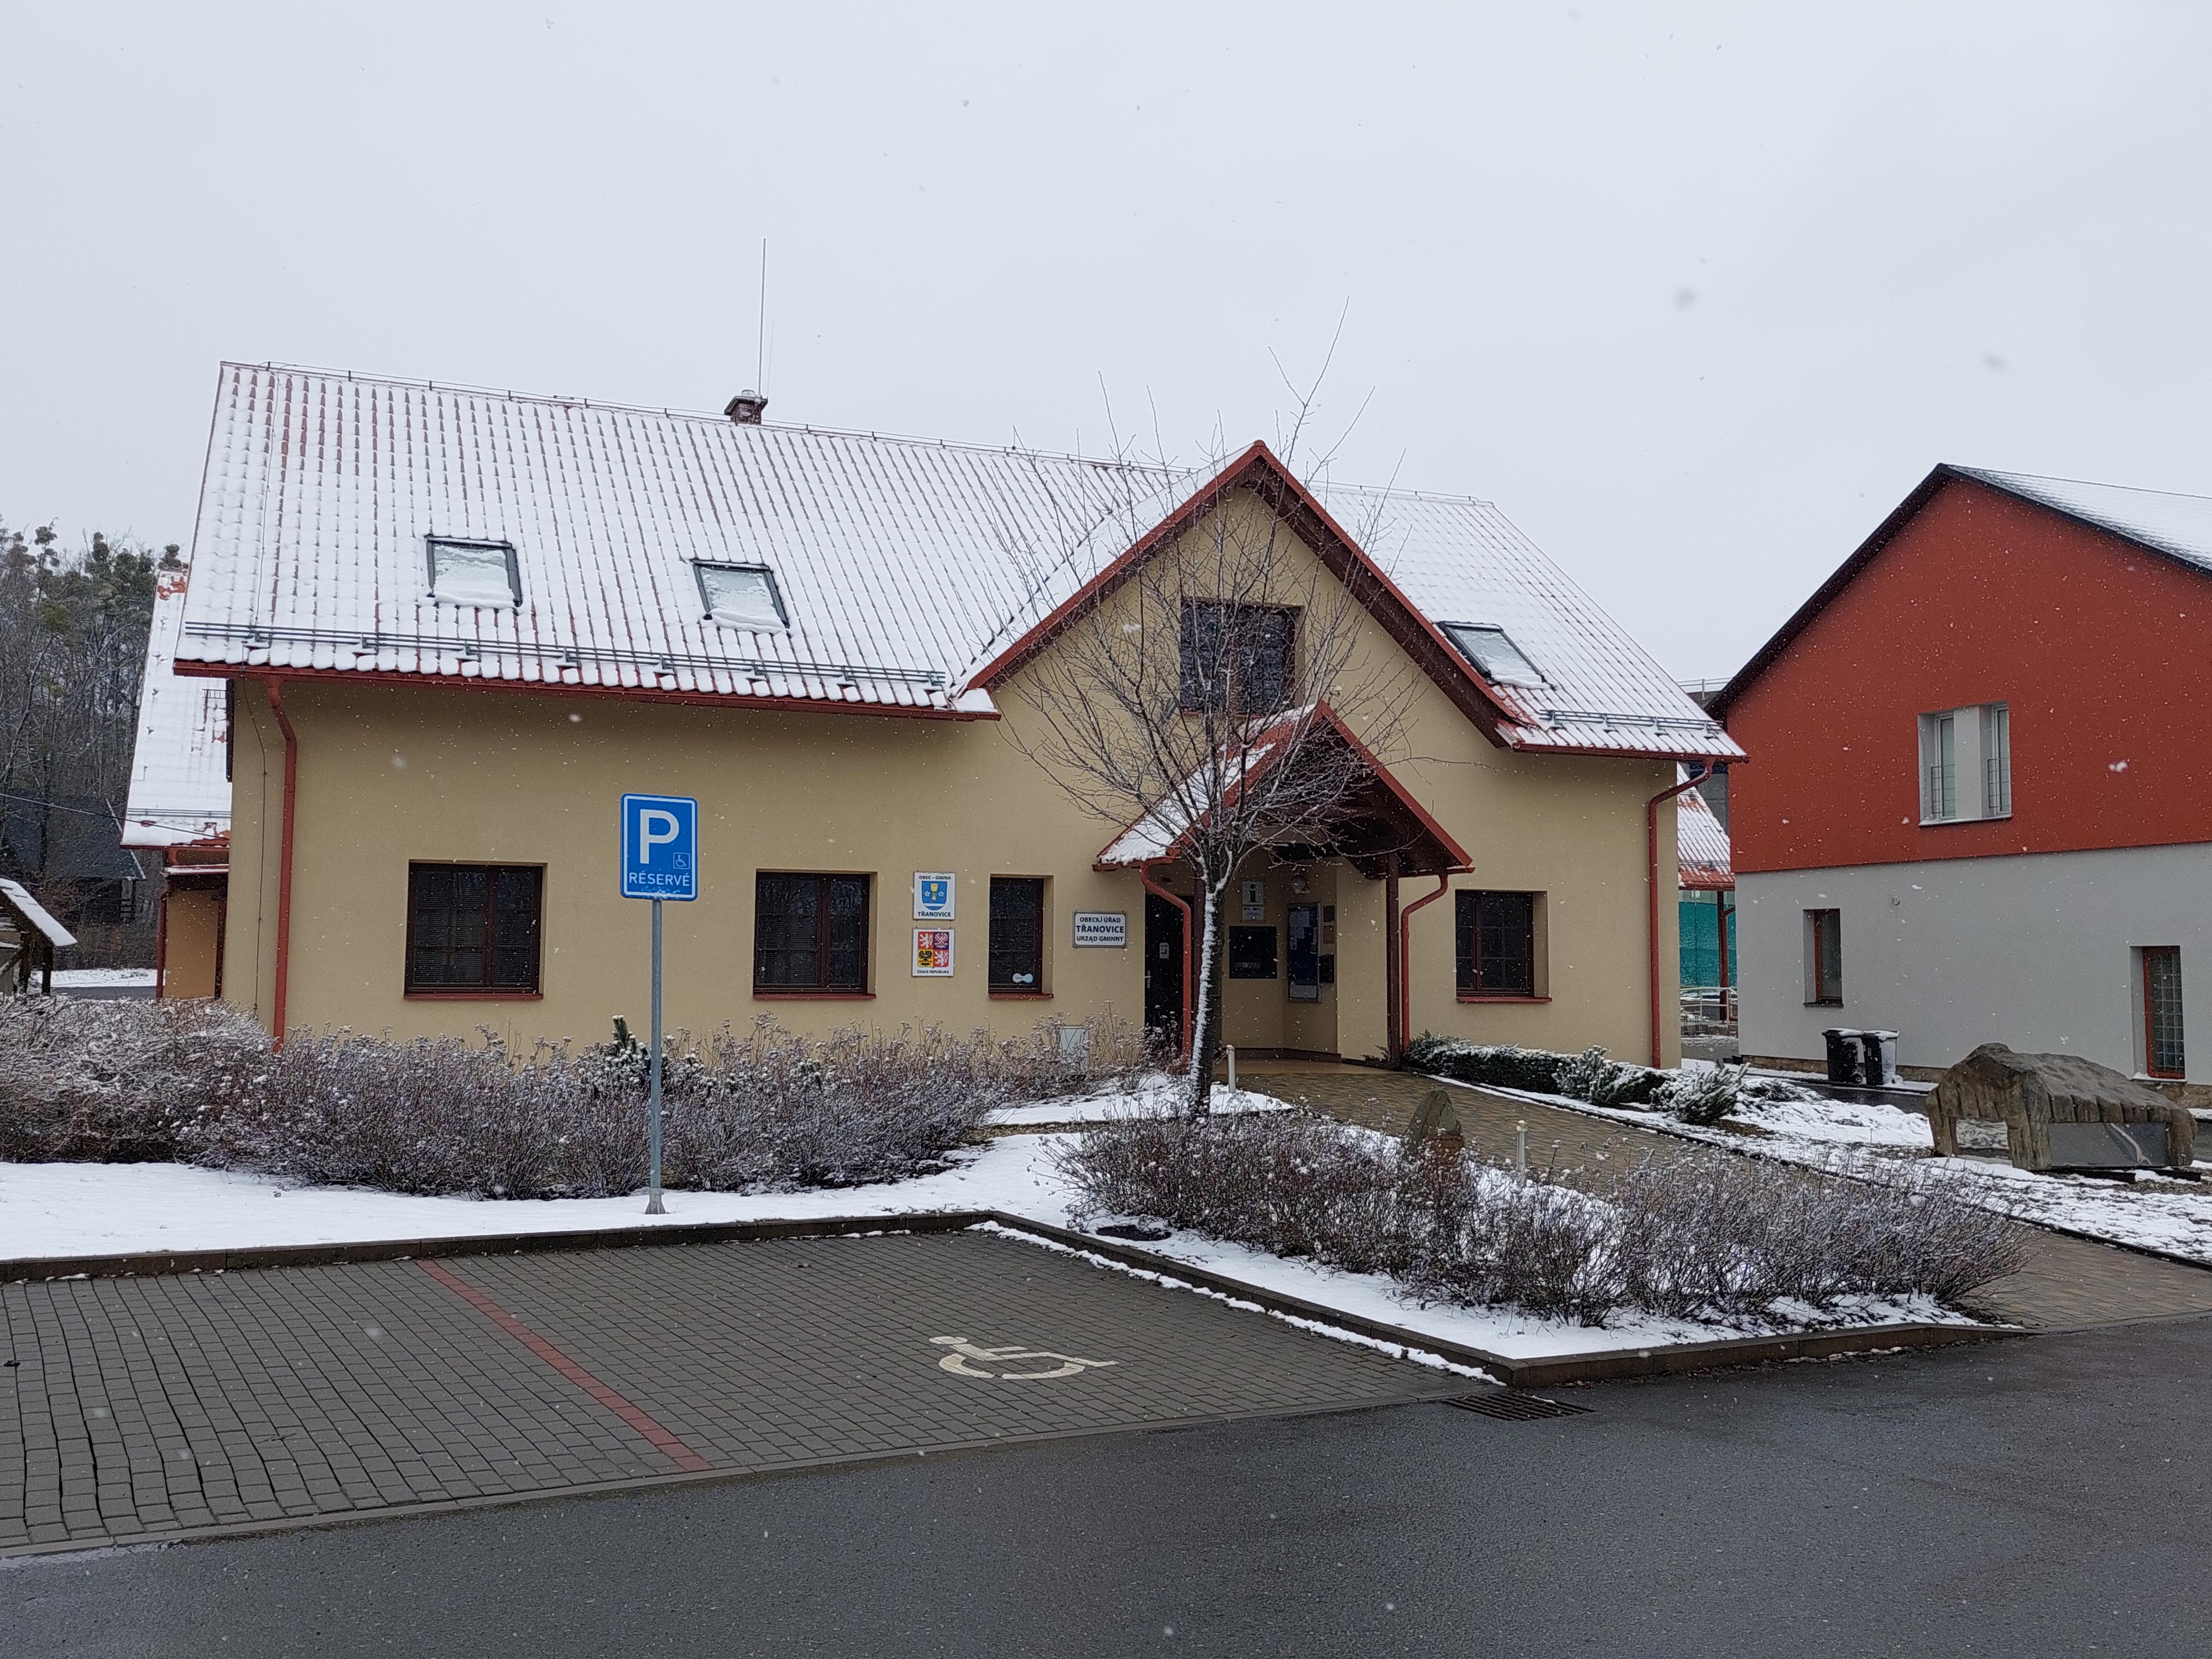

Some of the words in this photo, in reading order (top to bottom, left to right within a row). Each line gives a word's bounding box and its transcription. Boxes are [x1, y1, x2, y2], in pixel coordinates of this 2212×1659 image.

[640, 809, 679, 864] P
[629, 870, 690, 886] RÉSERVÉ
[1076, 924, 1124, 933] TŘANOVICE
